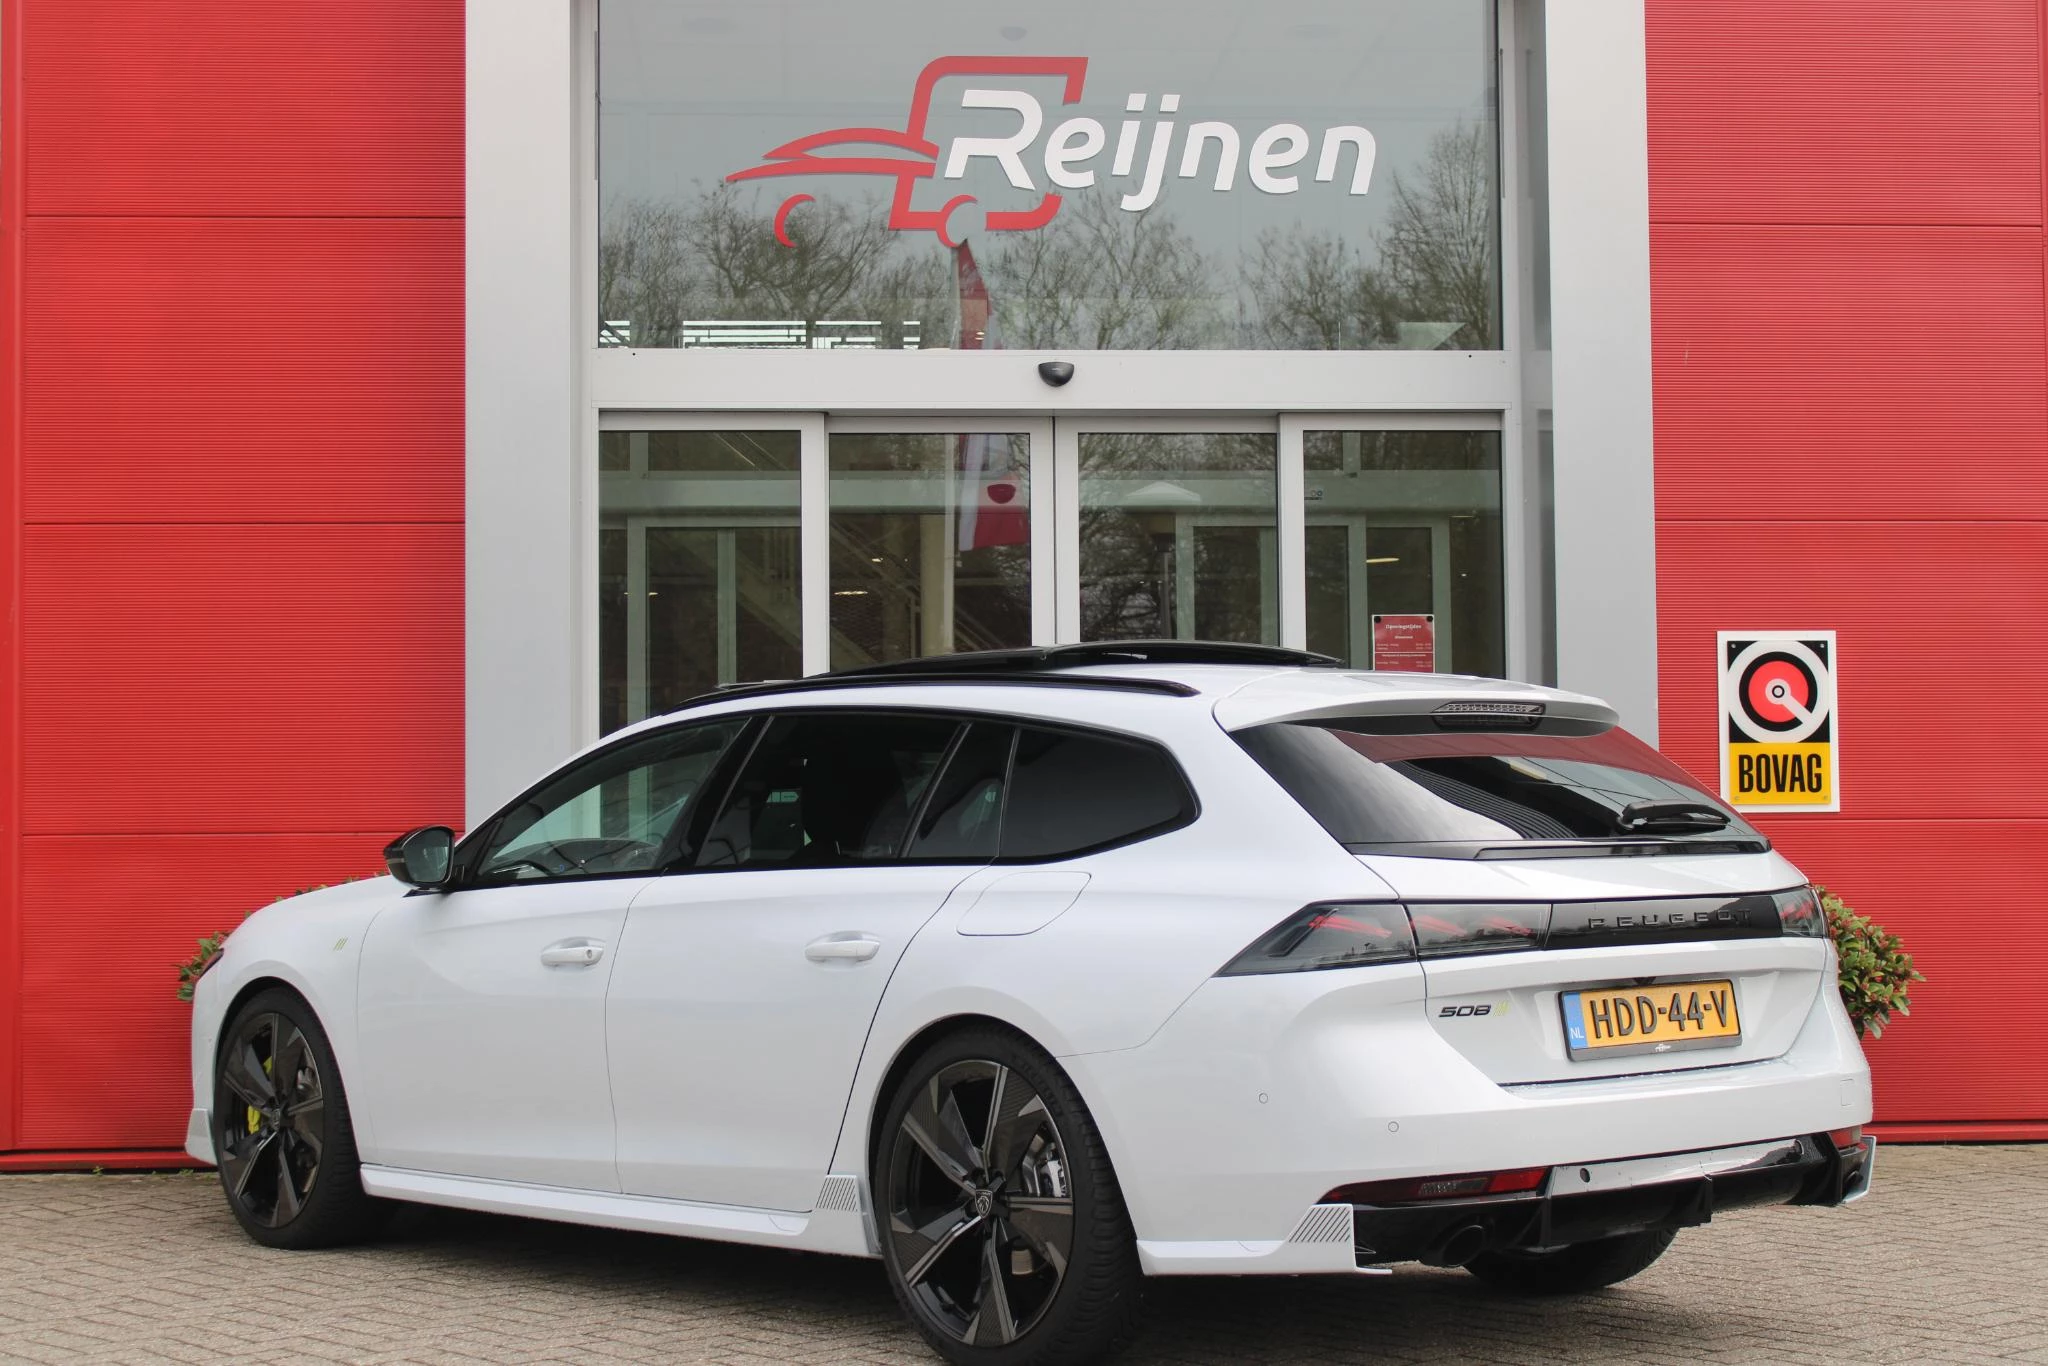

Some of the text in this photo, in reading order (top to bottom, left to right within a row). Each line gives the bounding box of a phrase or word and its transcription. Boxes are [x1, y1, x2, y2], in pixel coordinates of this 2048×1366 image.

[944, 89, 1377, 212] Reijnen
[1738, 753, 1823, 793] BOVAG
[1588, 908, 1752, 929] PEUGEOT
[1438, 1004, 1491, 1018] 508
[1589, 989, 1728, 1039] HDD-44-V
[1569, 1027, 1585, 1040] NL
